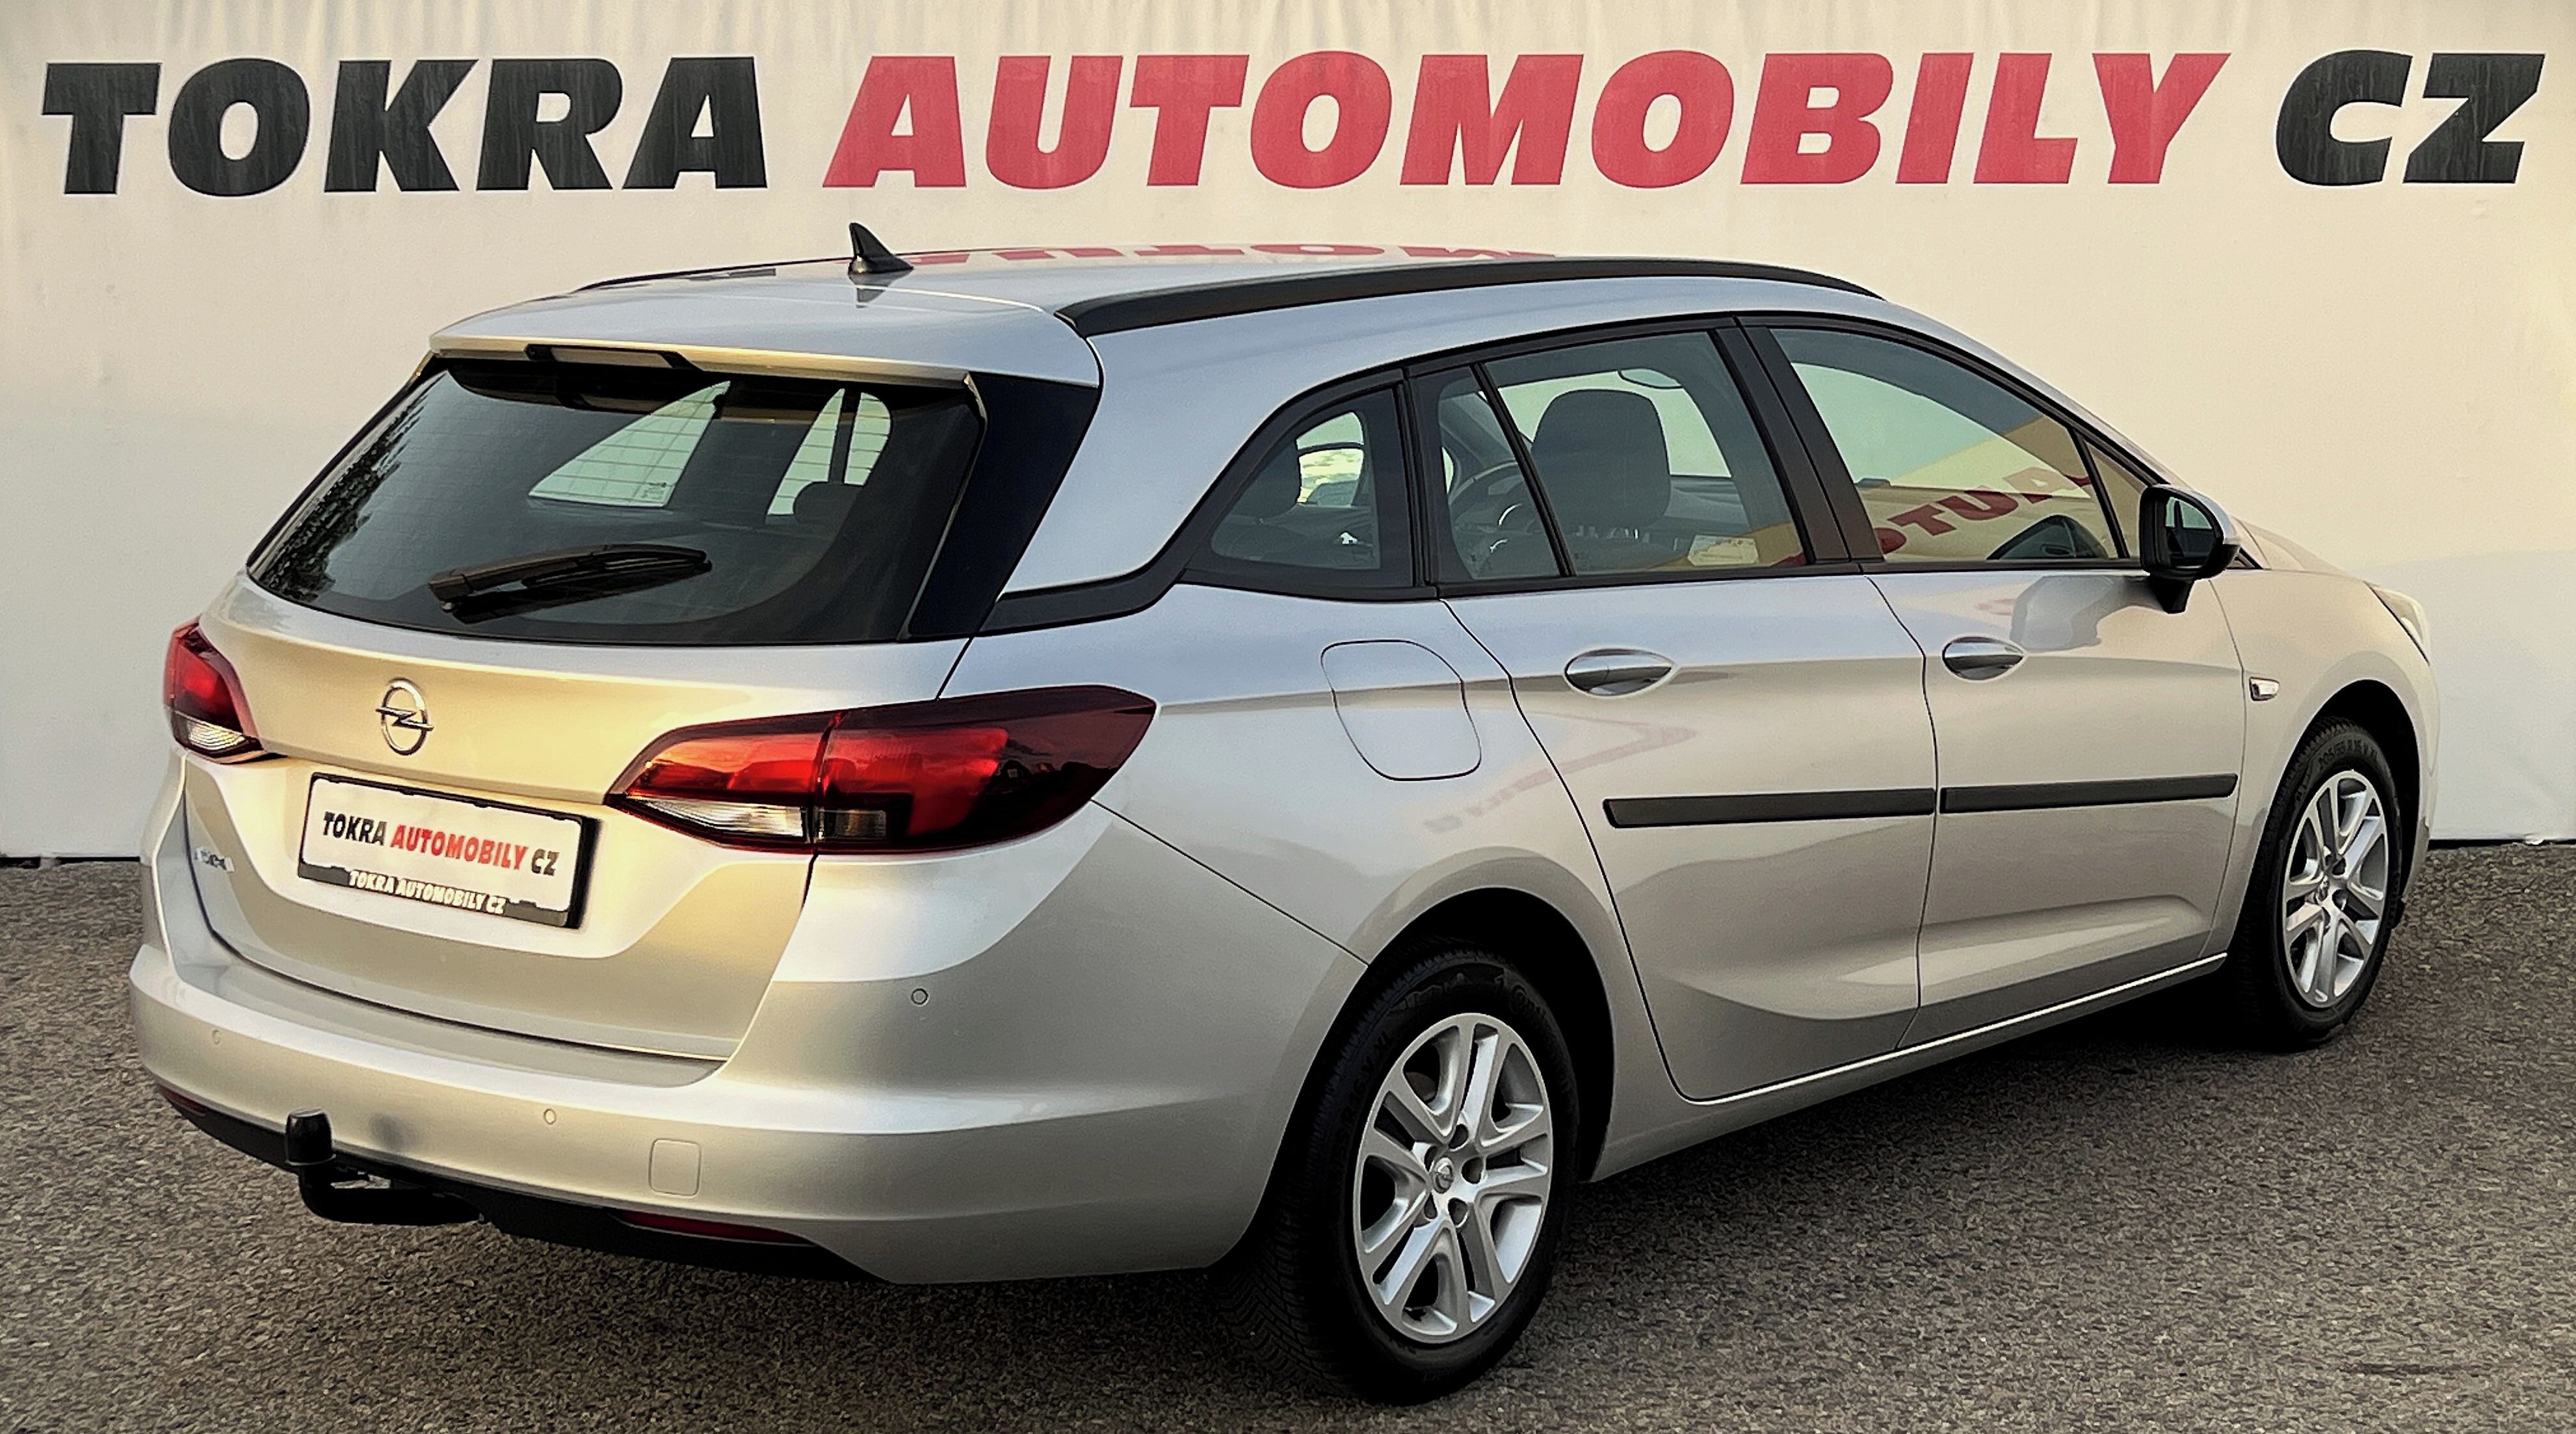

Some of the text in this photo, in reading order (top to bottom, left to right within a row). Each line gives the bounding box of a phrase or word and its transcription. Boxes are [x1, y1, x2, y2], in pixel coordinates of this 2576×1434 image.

[41, 49, 2545, 197] TOKRA AUTOMOBILY CZ
[323, 811, 560, 877] TOKRA AUTOMOBILY CZ
[349, 870, 506, 914] TOKRA AUTOMOBILY CZ
